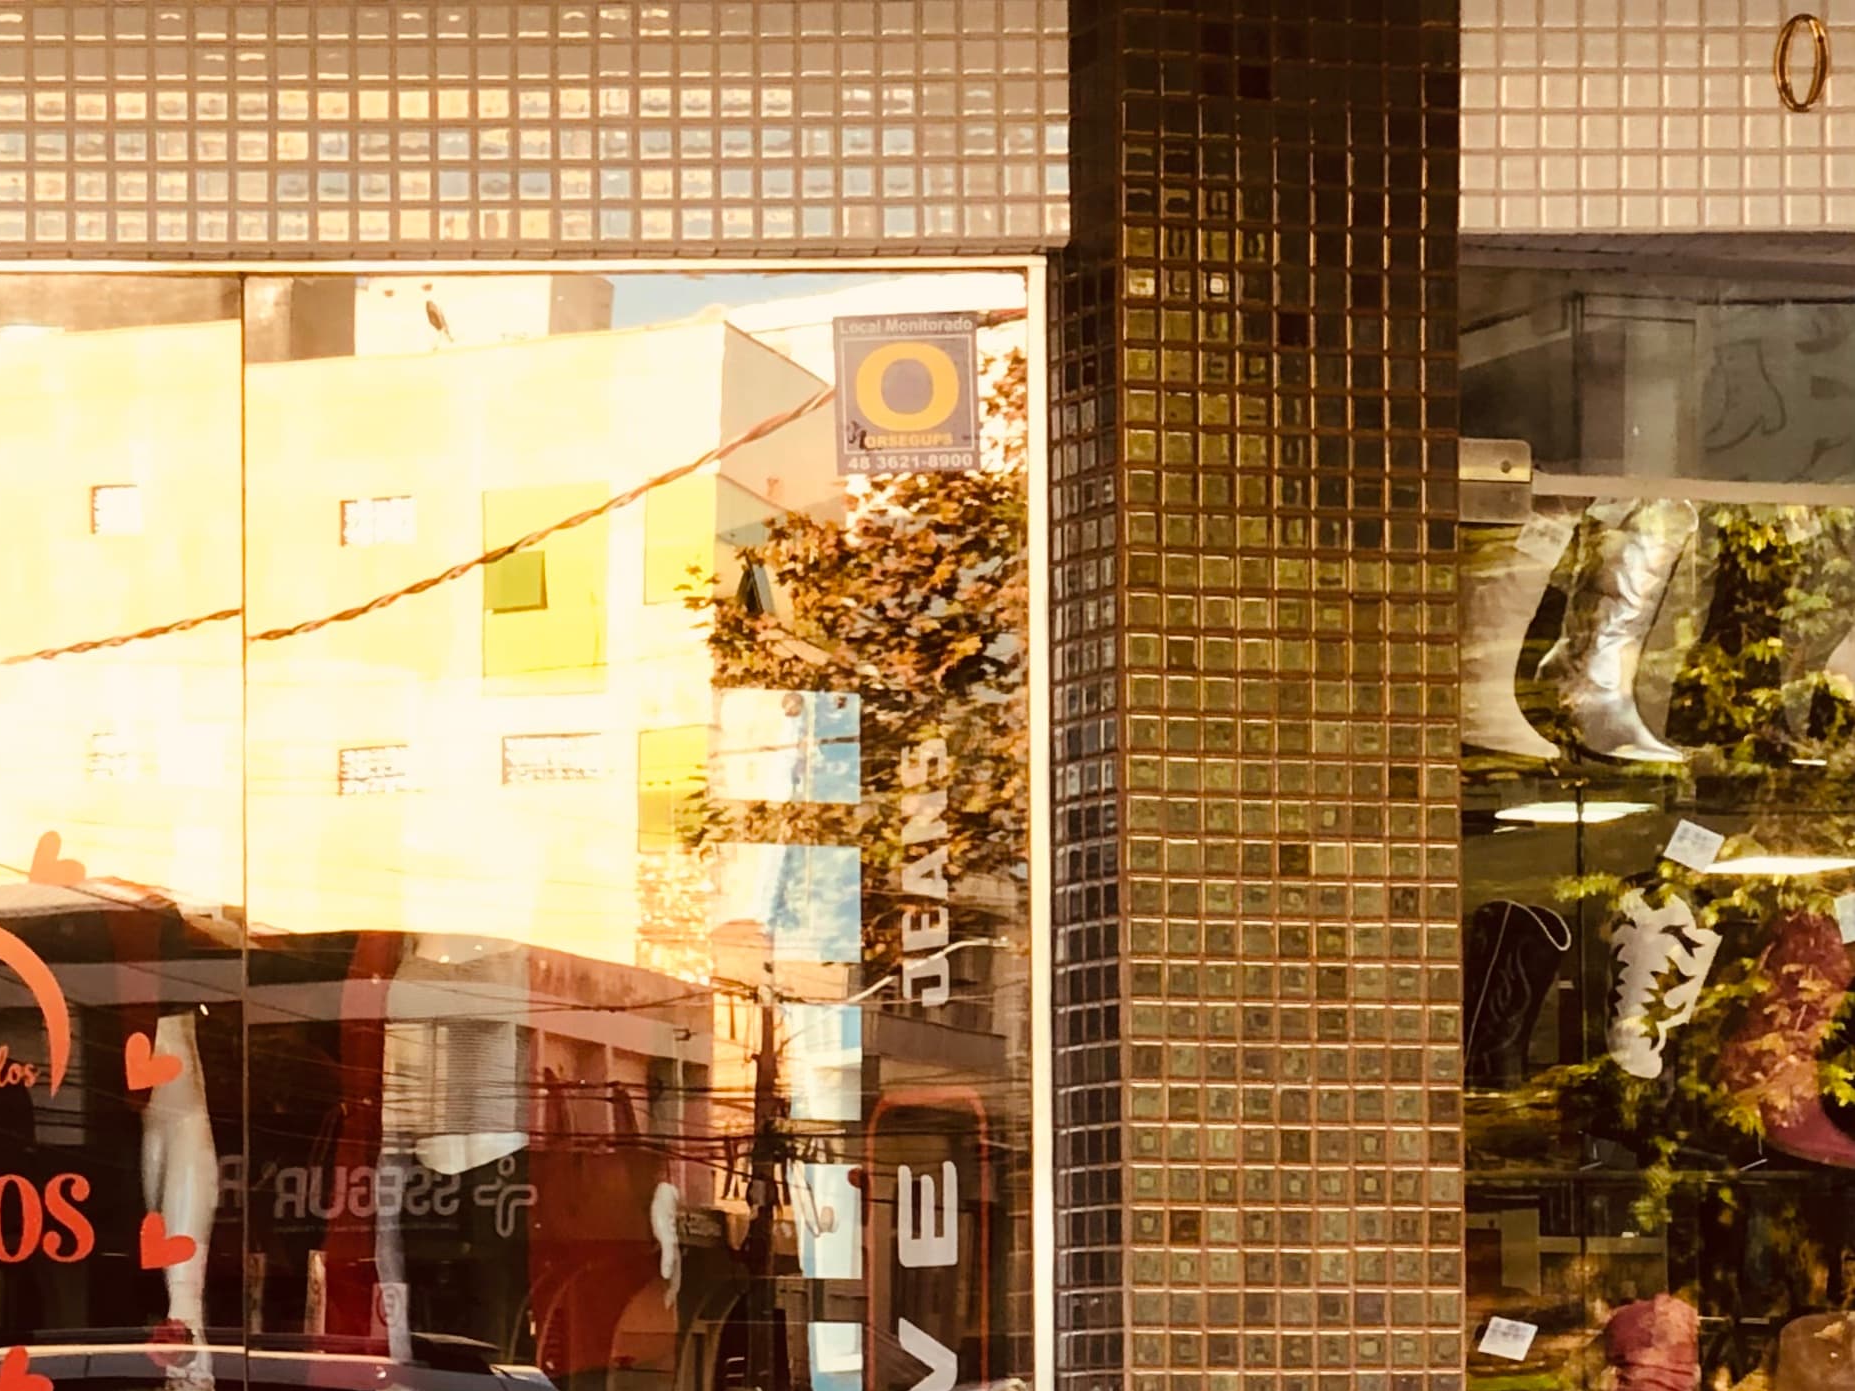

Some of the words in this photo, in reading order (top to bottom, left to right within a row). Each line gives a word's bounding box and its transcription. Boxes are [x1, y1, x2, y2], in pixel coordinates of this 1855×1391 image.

[839, 319, 881, 335] Local
[886, 317, 973, 333] Monitorado
[865, 432, 953, 448] ORSEGUPS
[848, 456, 870, 470] 48
[877, 453, 973, 469] 3621-8900
[901, 738, 949, 1007] JEANS
